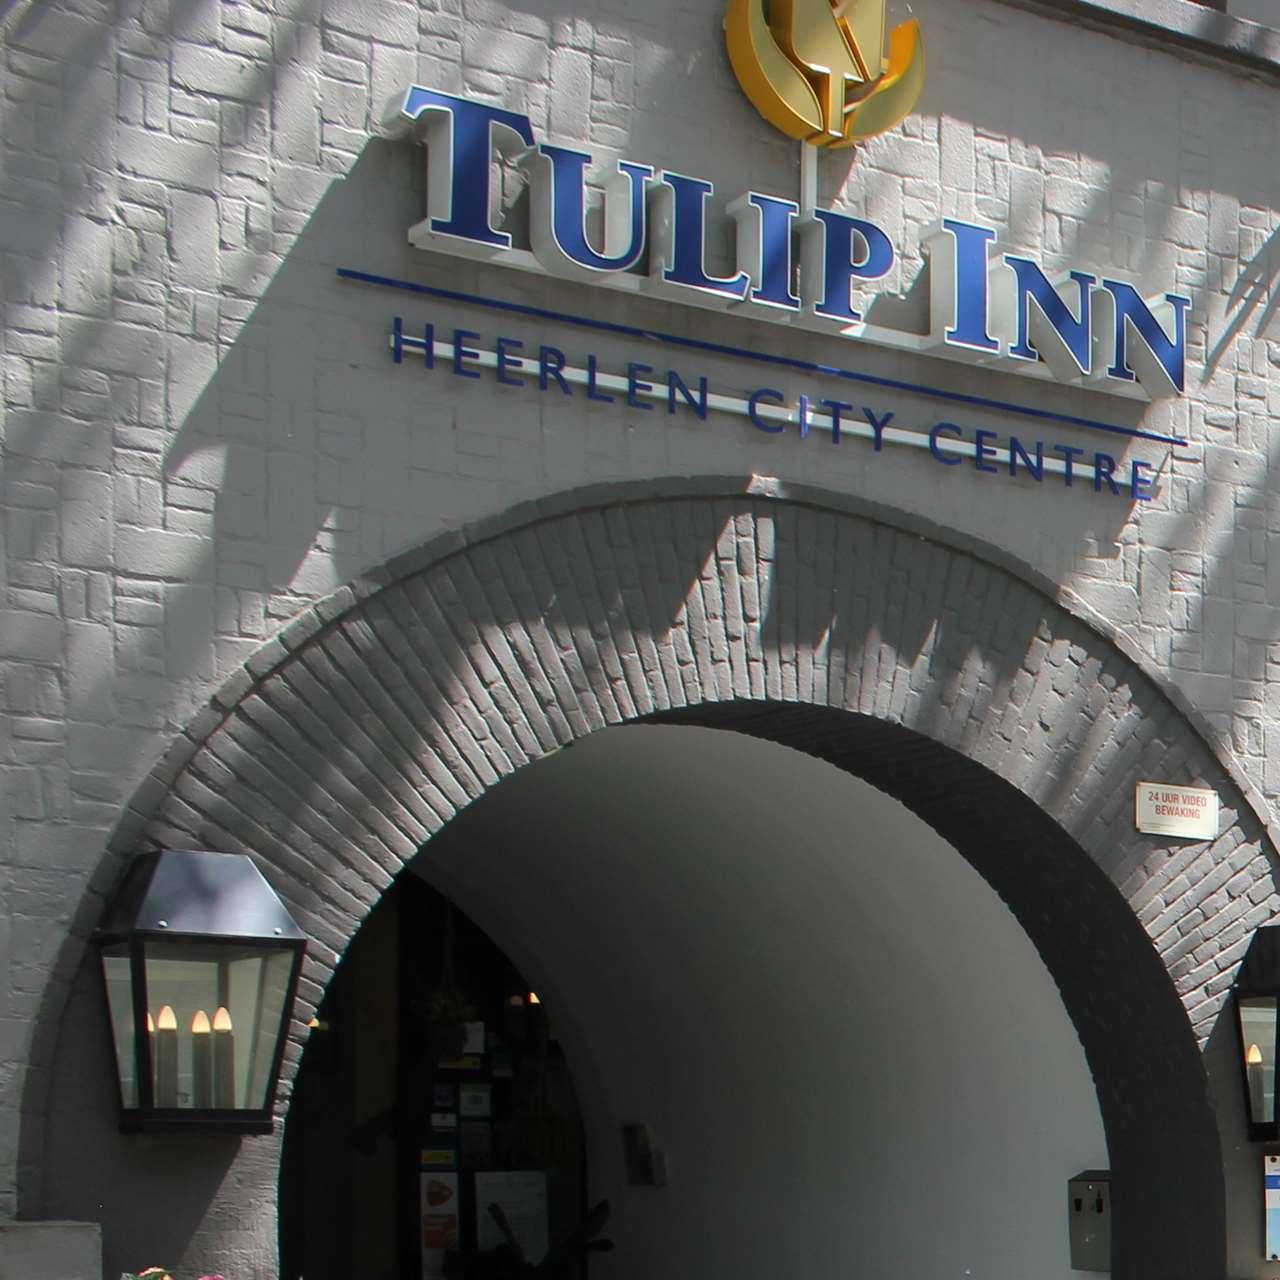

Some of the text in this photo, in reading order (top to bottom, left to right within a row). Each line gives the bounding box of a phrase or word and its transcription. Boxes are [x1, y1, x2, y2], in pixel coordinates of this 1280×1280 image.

[402, 85, 1191, 395] TULIP INN
[391, 316, 1155, 501] HEERLEN CITY CENTRE
[1148, 791, 1207, 807] 24 UUR VIDEO
[1155, 805, 1201, 819] BEWAKING
